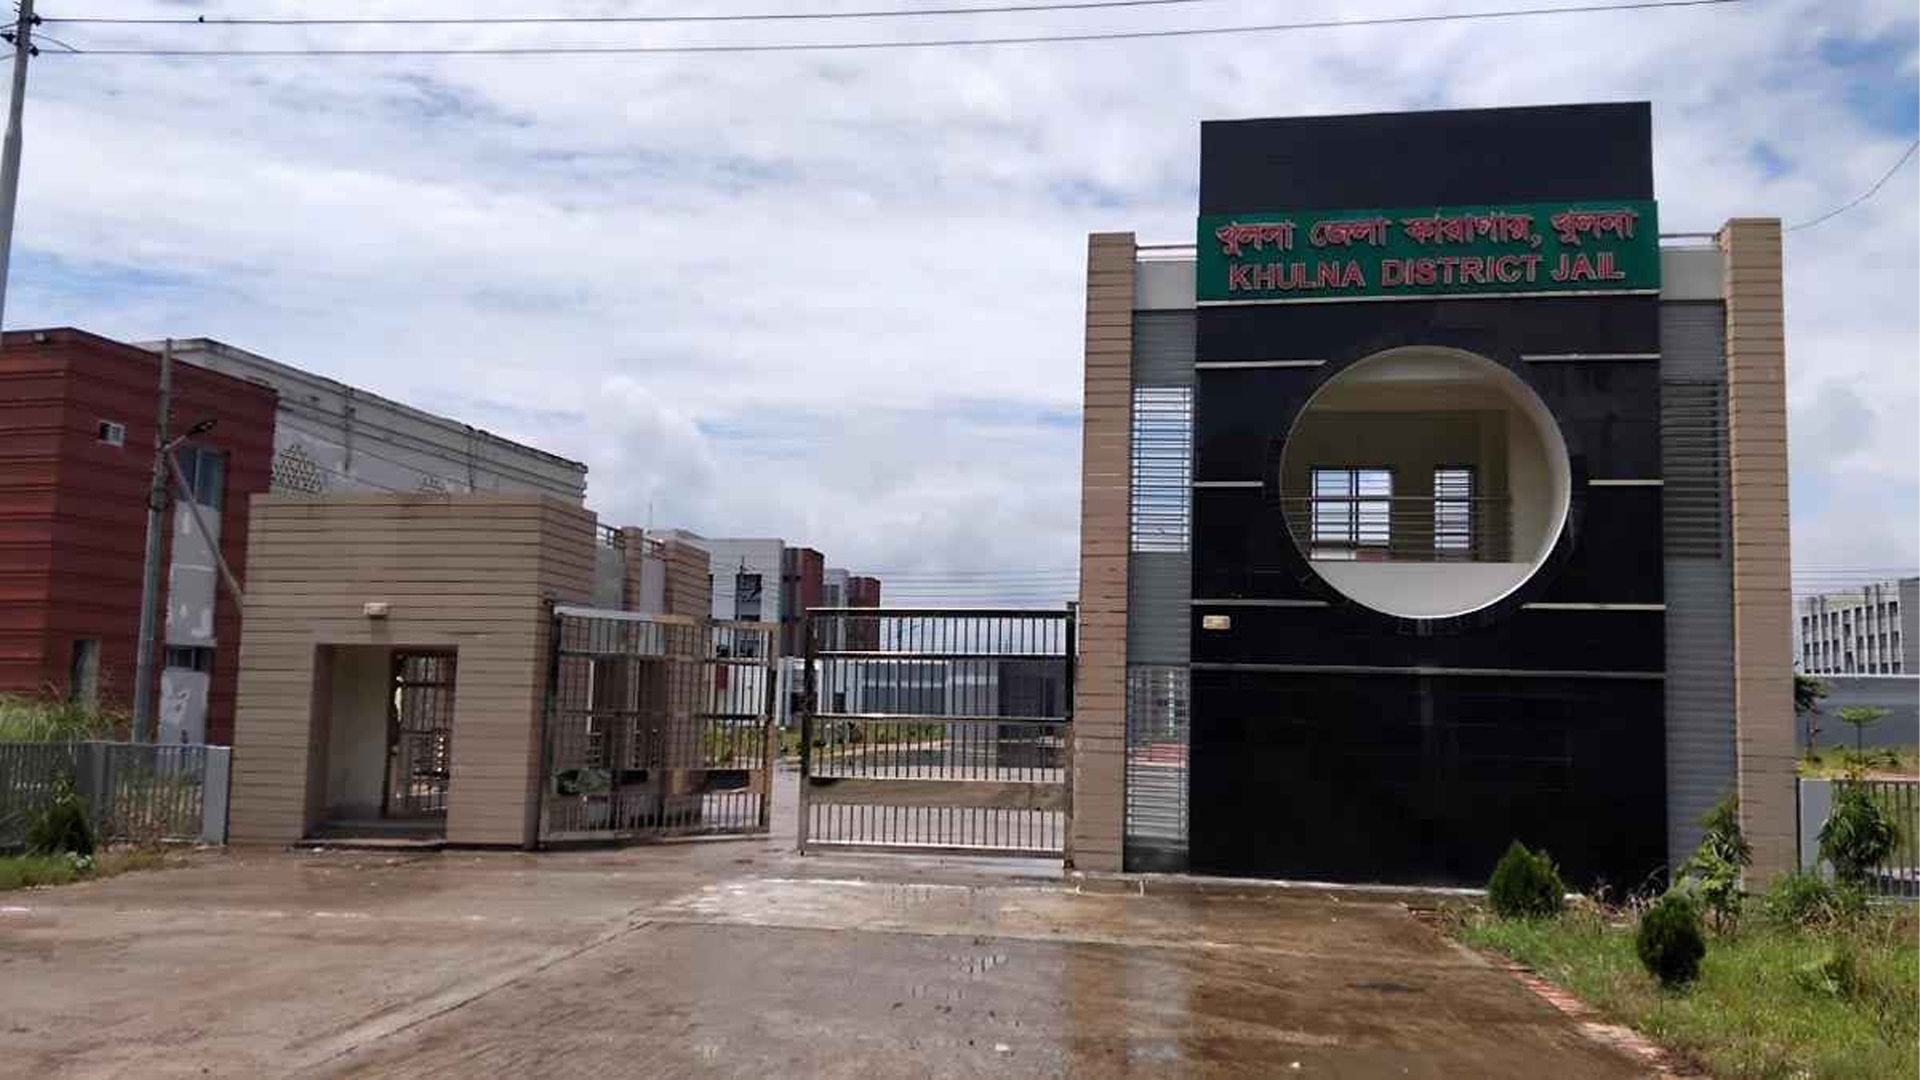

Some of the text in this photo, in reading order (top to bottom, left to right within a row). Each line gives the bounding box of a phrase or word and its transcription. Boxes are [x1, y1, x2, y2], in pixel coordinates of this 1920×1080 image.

[1217, 209, 1638, 256] খুলনা জেলা কারাগার, খুলনা
[1229, 252, 1626, 291] KHULNA DISTRICT JAIL
